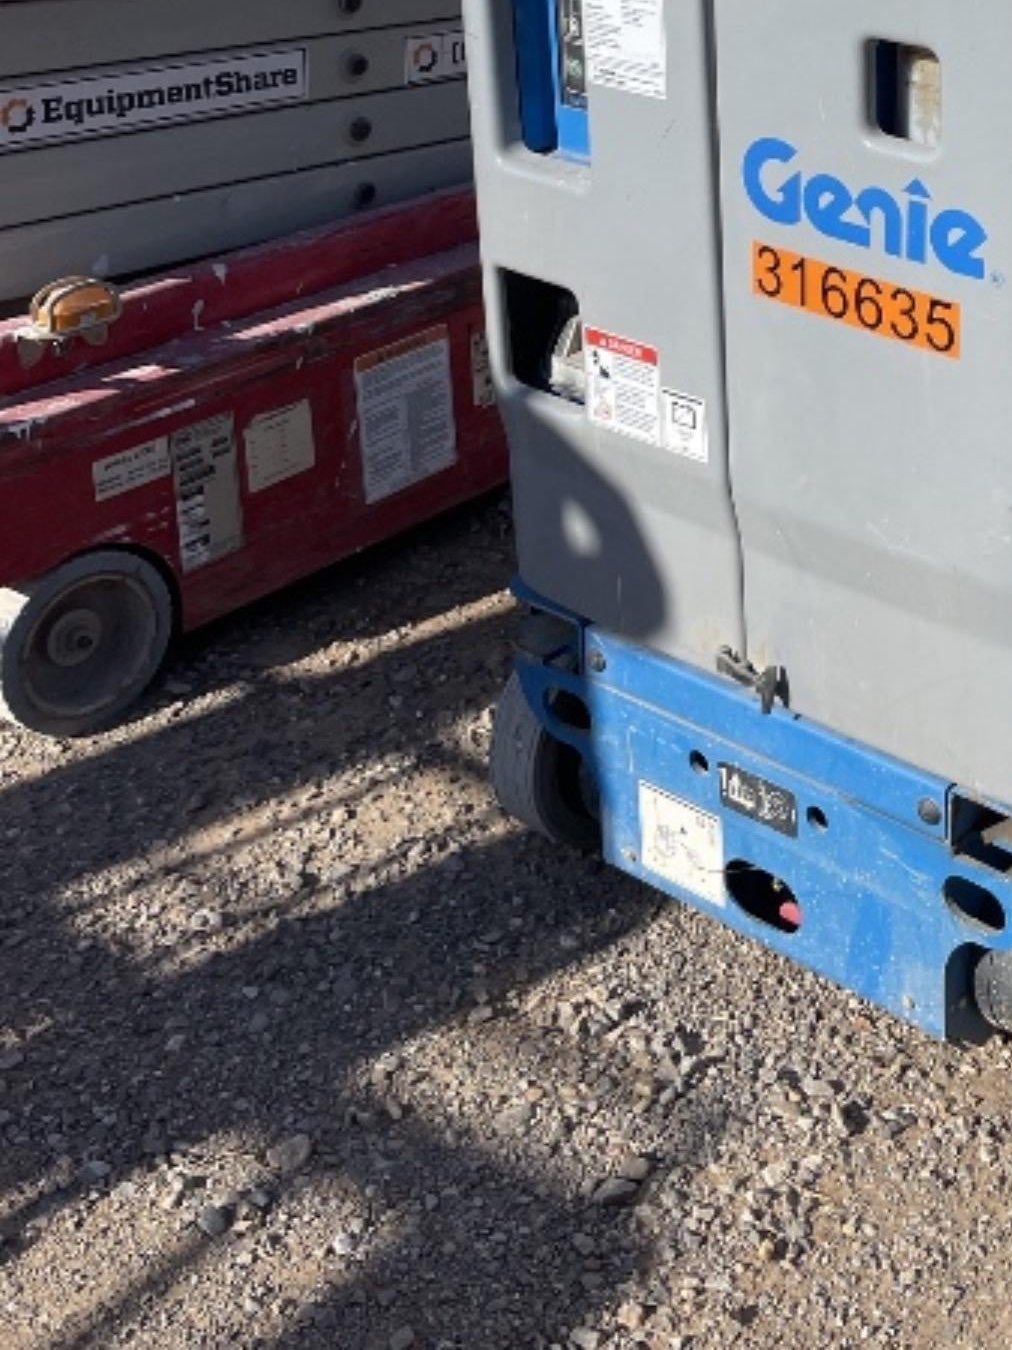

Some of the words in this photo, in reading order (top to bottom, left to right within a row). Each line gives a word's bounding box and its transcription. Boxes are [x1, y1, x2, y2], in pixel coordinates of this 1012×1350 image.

[39, 65, 298, 127] EquipmentShare
[742, 136, 988, 280] Genie
[756, 245, 956, 353] 316635
